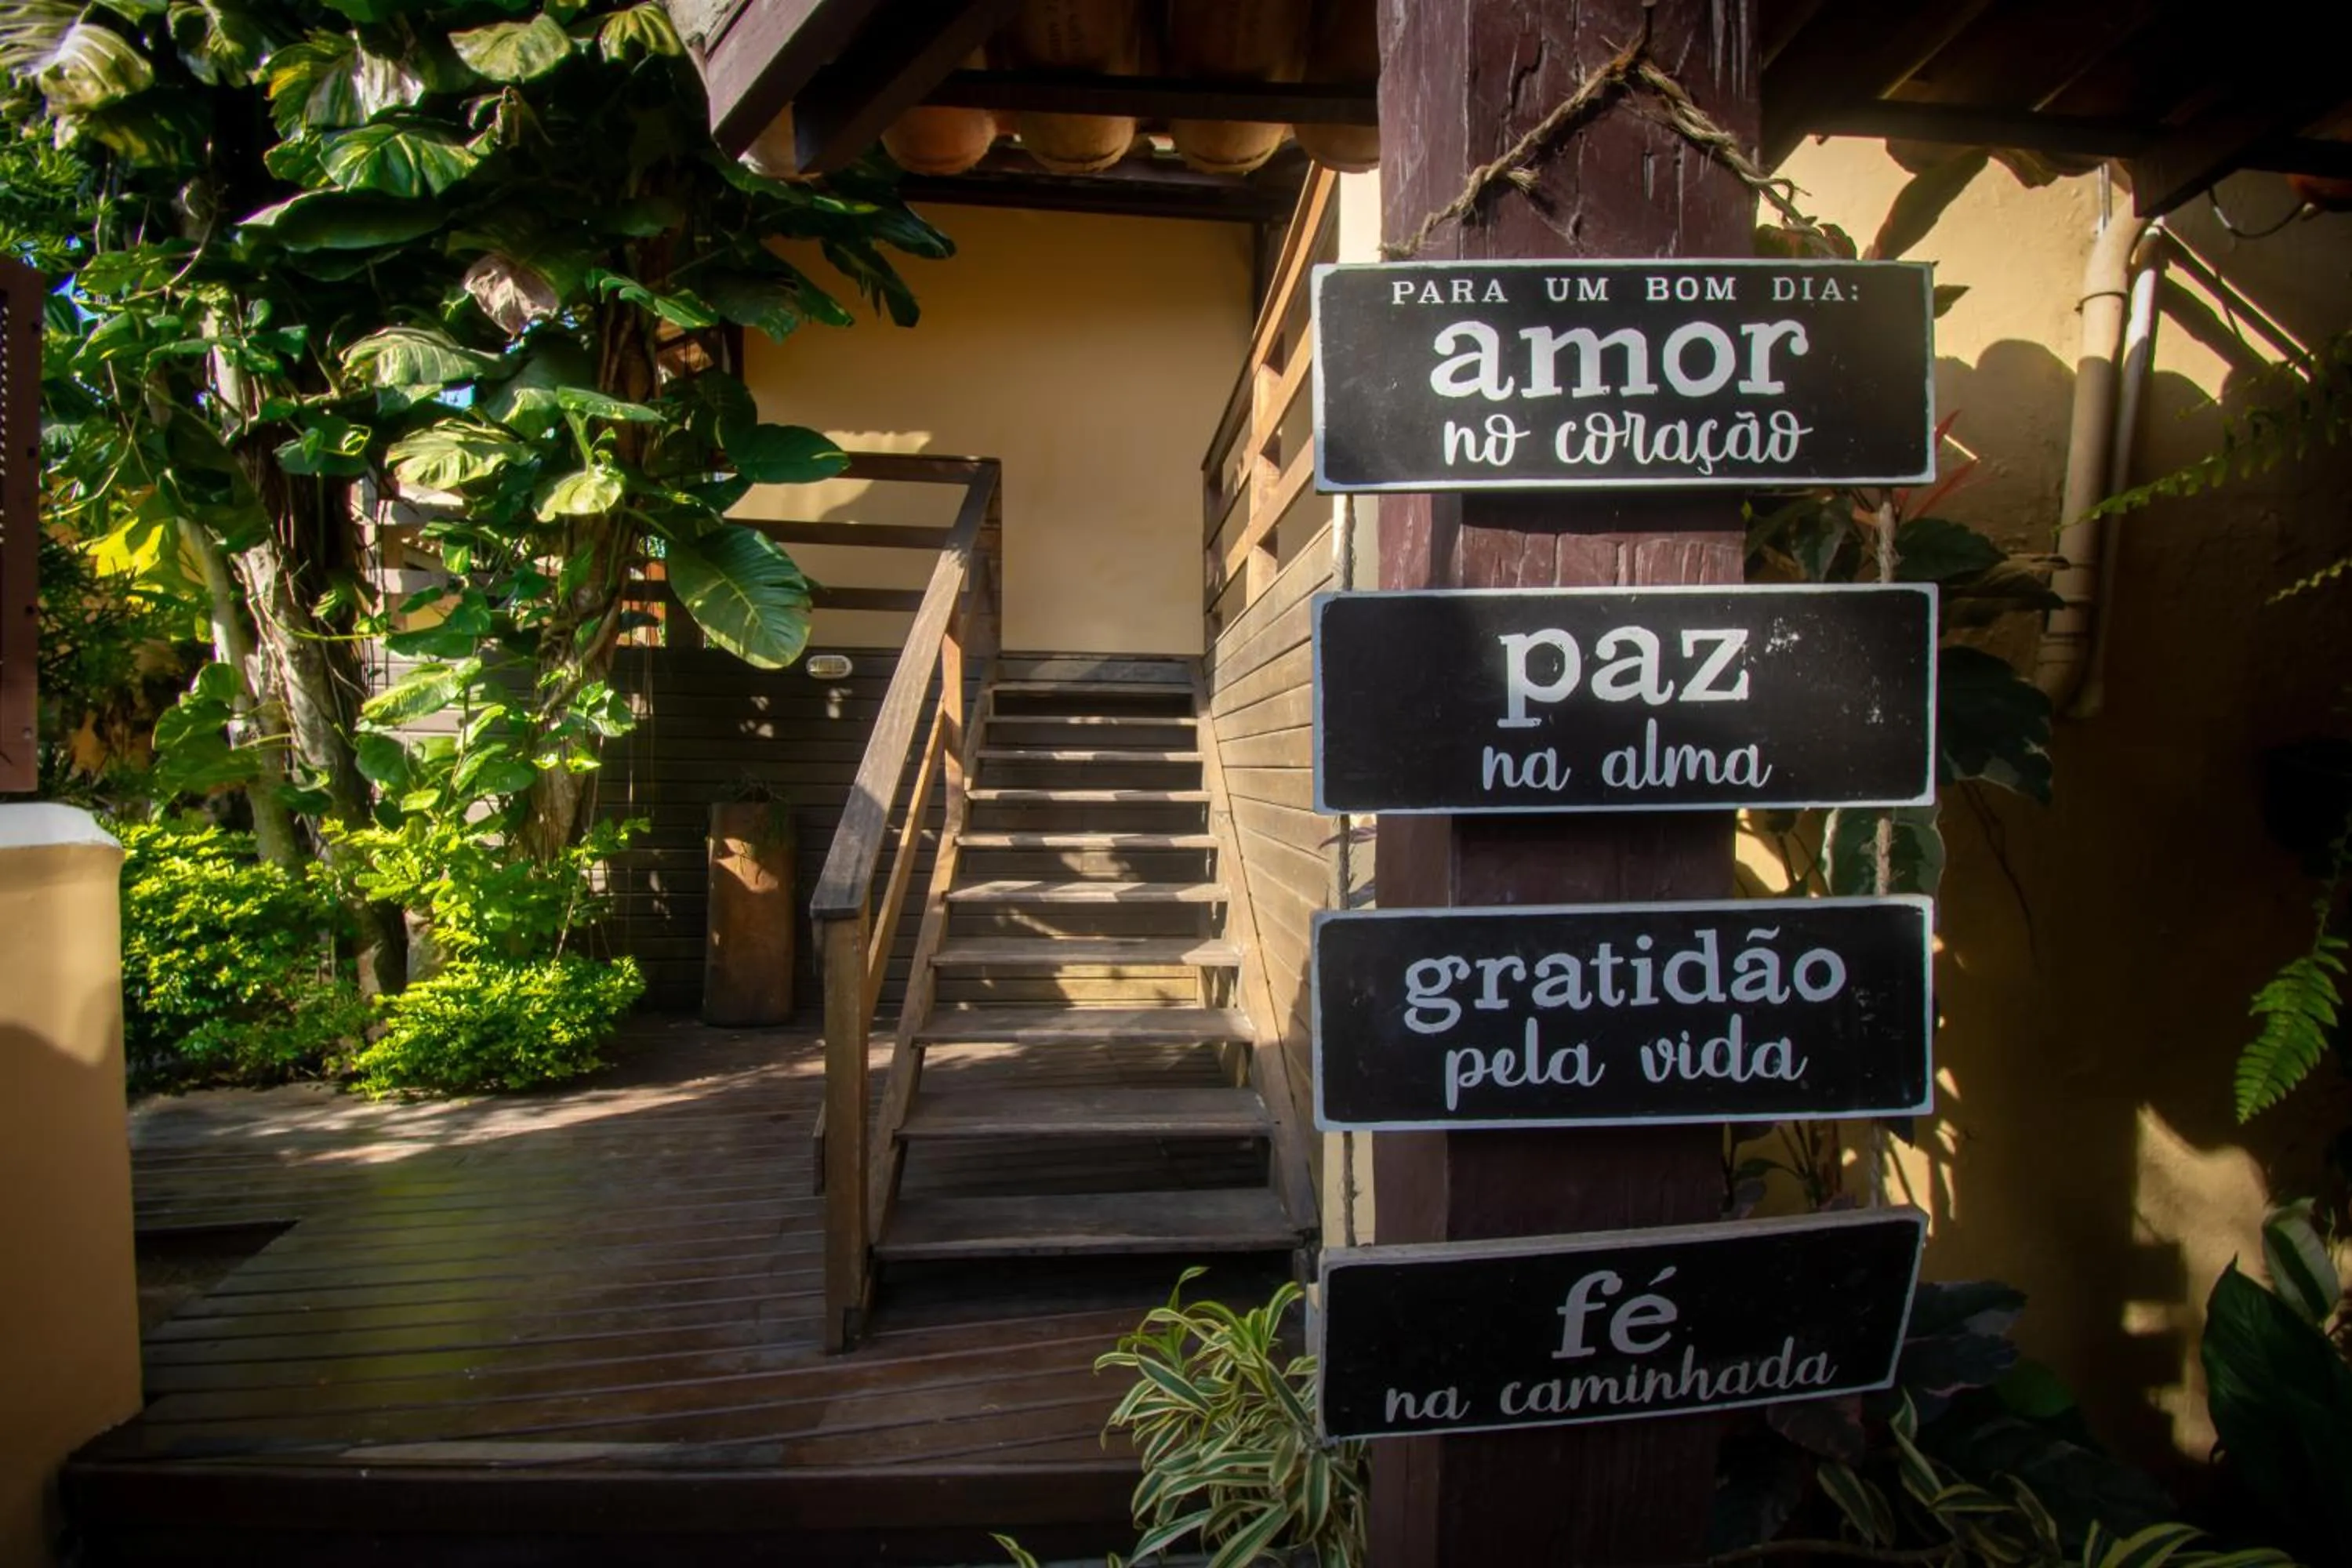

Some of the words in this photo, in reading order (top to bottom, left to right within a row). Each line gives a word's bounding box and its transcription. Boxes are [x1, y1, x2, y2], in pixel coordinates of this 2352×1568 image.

[1391, 279, 1509, 306] PARA
[1544, 277, 1610, 302] UM
[1645, 276, 1737, 302] BOM
[1772, 277, 1860, 302] DIA:
[1428, 319, 1809, 403] amor
[1443, 412, 1531, 468] no
[1554, 410, 1814, 476] coração
[1497, 624, 1750, 728] paz
[1482, 746, 1571, 791] na
[1602, 717, 1773, 790] alma
[1403, 926, 1846, 1034] gratidão
[1445, 1016, 1606, 1112] pela
[1640, 1013, 1808, 1083] vida
[1552, 1265, 1679, 1360] fé
[1384, 1386, 1469, 1423] na
[1498, 1337, 1838, 1415] caminhada
